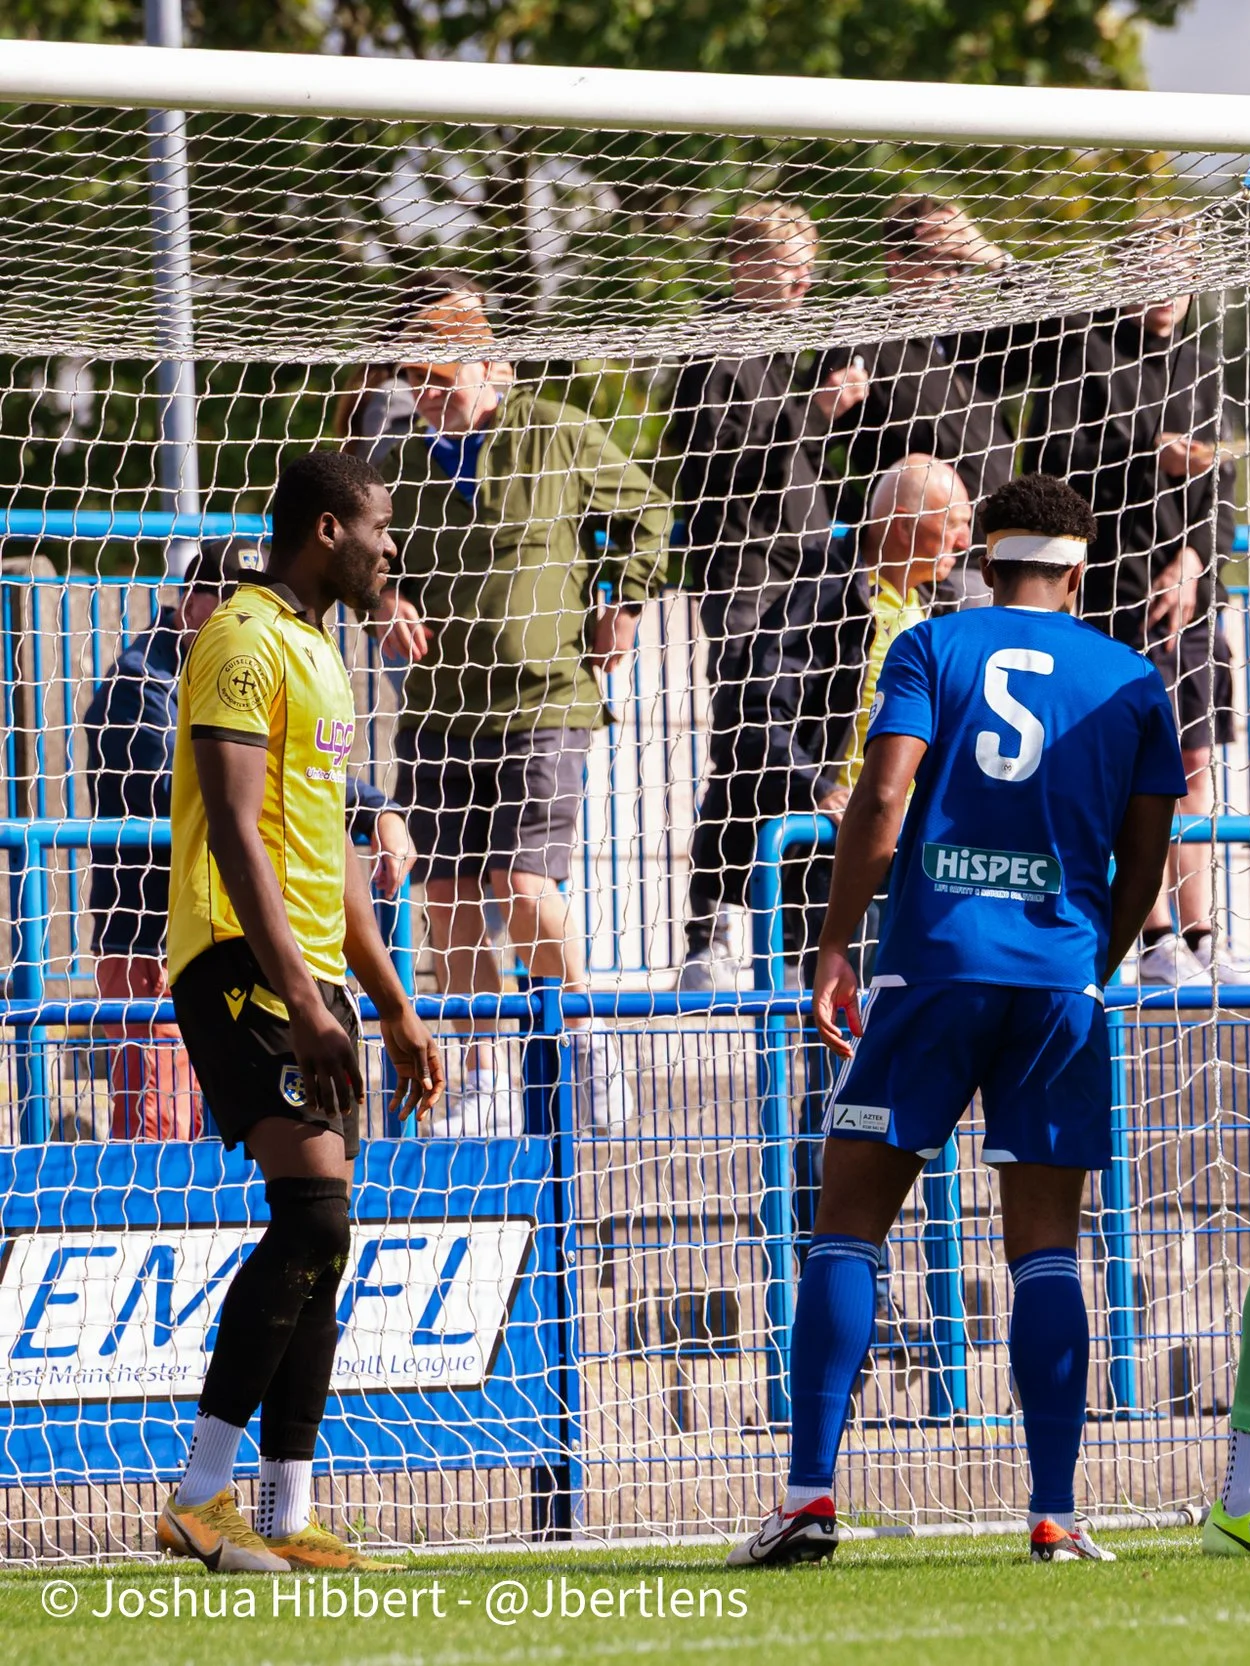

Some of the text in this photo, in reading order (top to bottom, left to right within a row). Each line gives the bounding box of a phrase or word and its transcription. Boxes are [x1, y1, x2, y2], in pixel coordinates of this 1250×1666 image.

[976, 648, 1054, 781] 5
[936, 849, 1048, 887] HiSPEC
[8, 1236, 476, 1359] EMFL
[50, 1364, 191, 1386] Manchester
[390, 1355, 475, 1379] League
